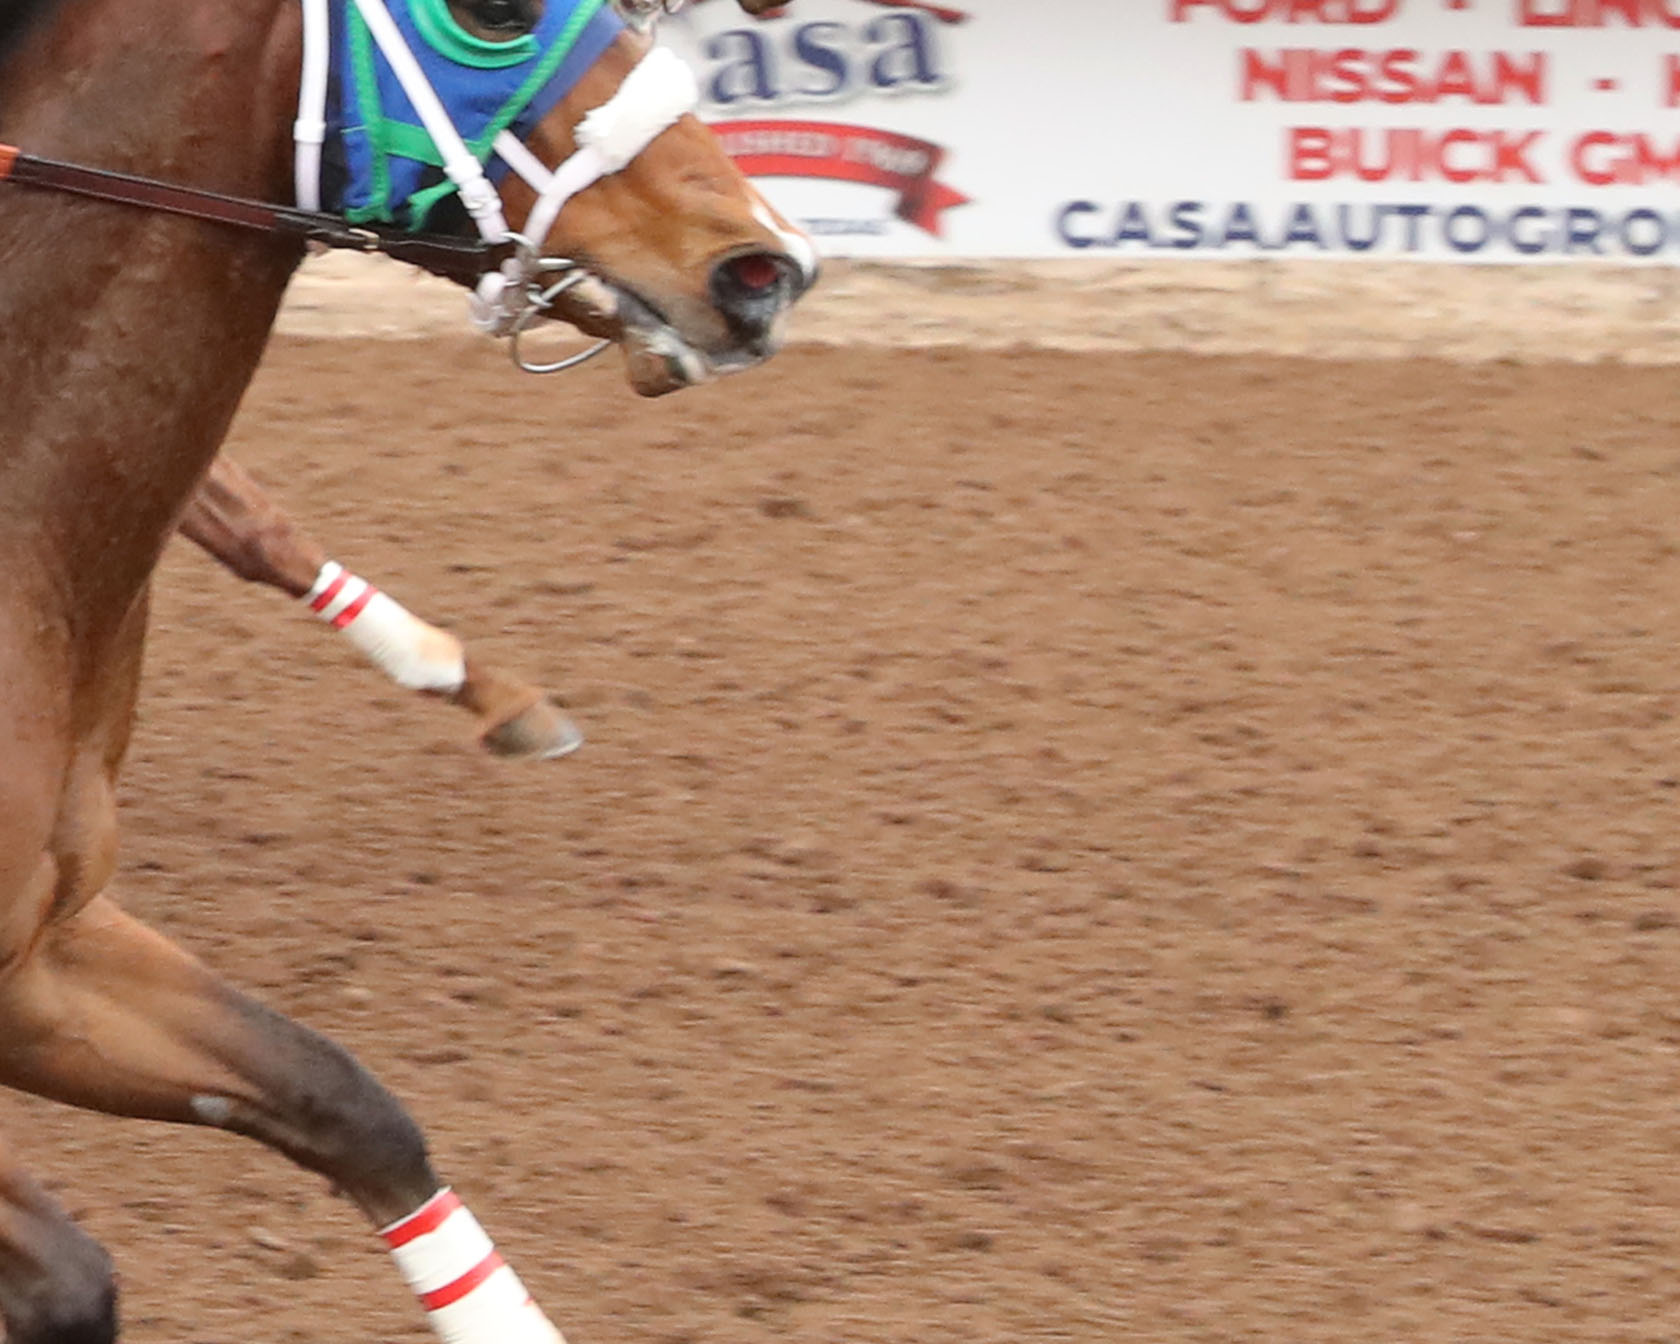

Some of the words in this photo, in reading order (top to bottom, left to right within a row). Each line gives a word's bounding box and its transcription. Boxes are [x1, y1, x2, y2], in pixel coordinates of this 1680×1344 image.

[704, 12, 944, 106] asa
[1238, 48, 1546, 105] NISSAN
[1285, 127, 1544, 184] BUICK
